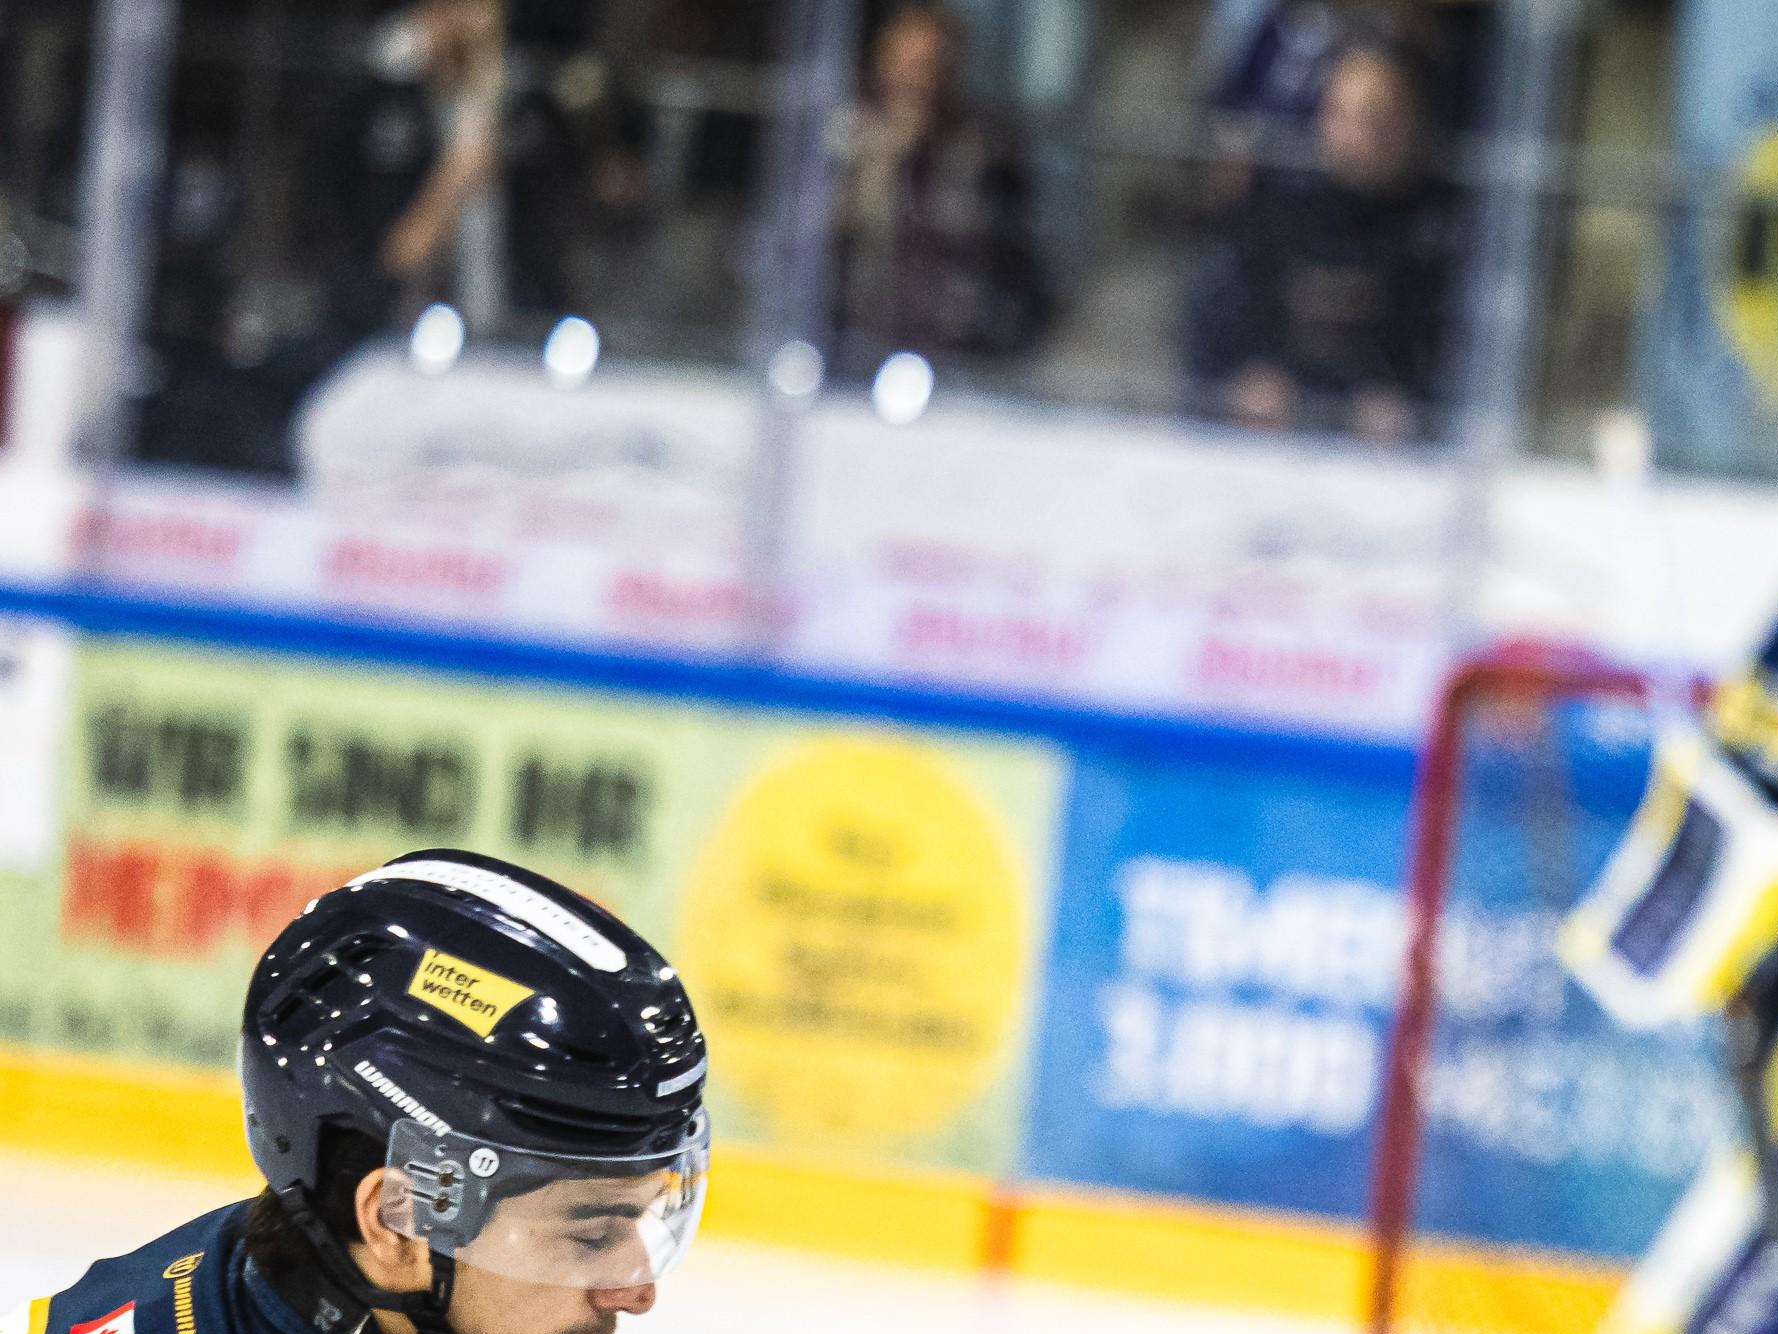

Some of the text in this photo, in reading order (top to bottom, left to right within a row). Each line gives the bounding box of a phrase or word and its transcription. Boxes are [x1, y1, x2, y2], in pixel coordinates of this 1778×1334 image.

[424, 951, 481, 989] inter
[421, 978, 499, 1019] wetten
[354, 1059, 452, 1137] WARRIOR
